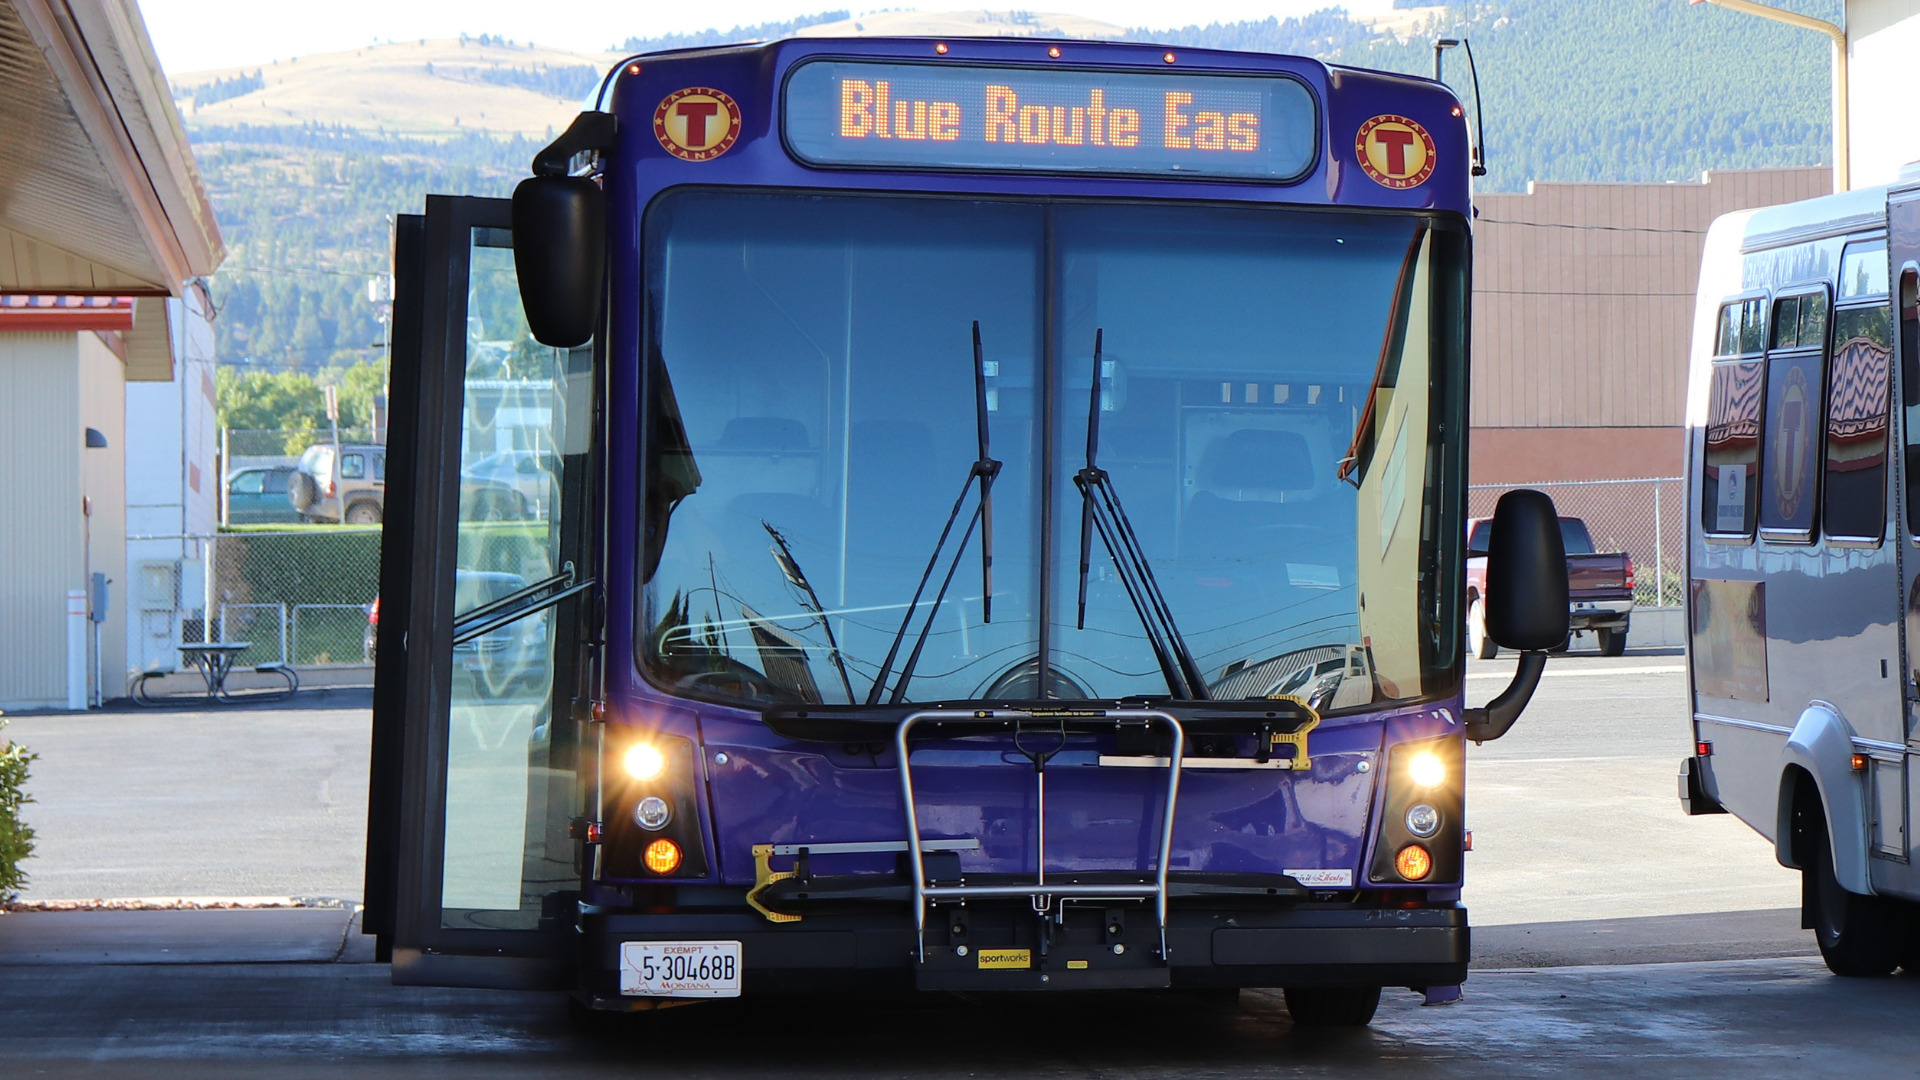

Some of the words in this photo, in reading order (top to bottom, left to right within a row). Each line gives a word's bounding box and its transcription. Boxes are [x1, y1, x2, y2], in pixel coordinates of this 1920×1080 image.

[660, 87, 735, 110] CAPITAL
[676, 102, 718, 147] T
[841, 79, 961, 140] Blue
[985, 84, 1140, 147] Route
[1164, 91, 1259, 151] Eas
[1360, 115, 1429, 139] CAPITAL
[660, 133, 734, 160] TRANSIT
[1375, 128, 1414, 175] T
[1362, 160, 1431, 187] TRANSIT
[664, 946, 704, 954] EXEMPT
[980, 953, 1029, 963] sportworks
